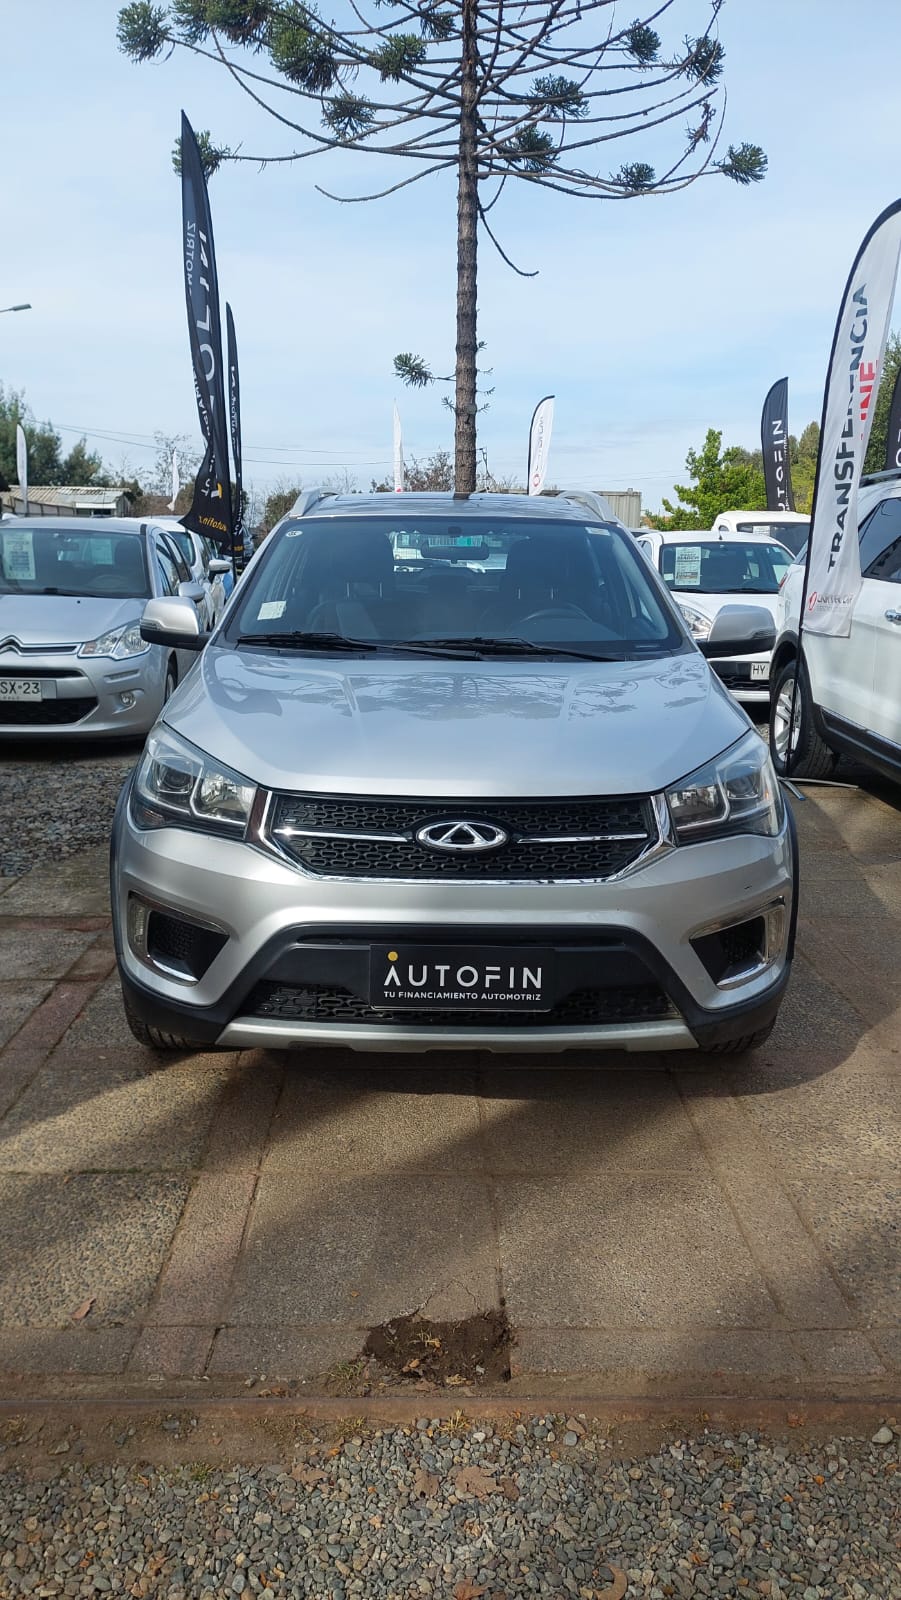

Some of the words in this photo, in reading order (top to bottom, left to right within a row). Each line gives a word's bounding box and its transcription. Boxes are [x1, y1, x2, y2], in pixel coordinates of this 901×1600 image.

[384, 963, 542, 989] AUTOFIN
[399, 991, 478, 1000] FINANCIAMIENTO
[481, 993, 541, 1001] AUTOMOTRIZ
